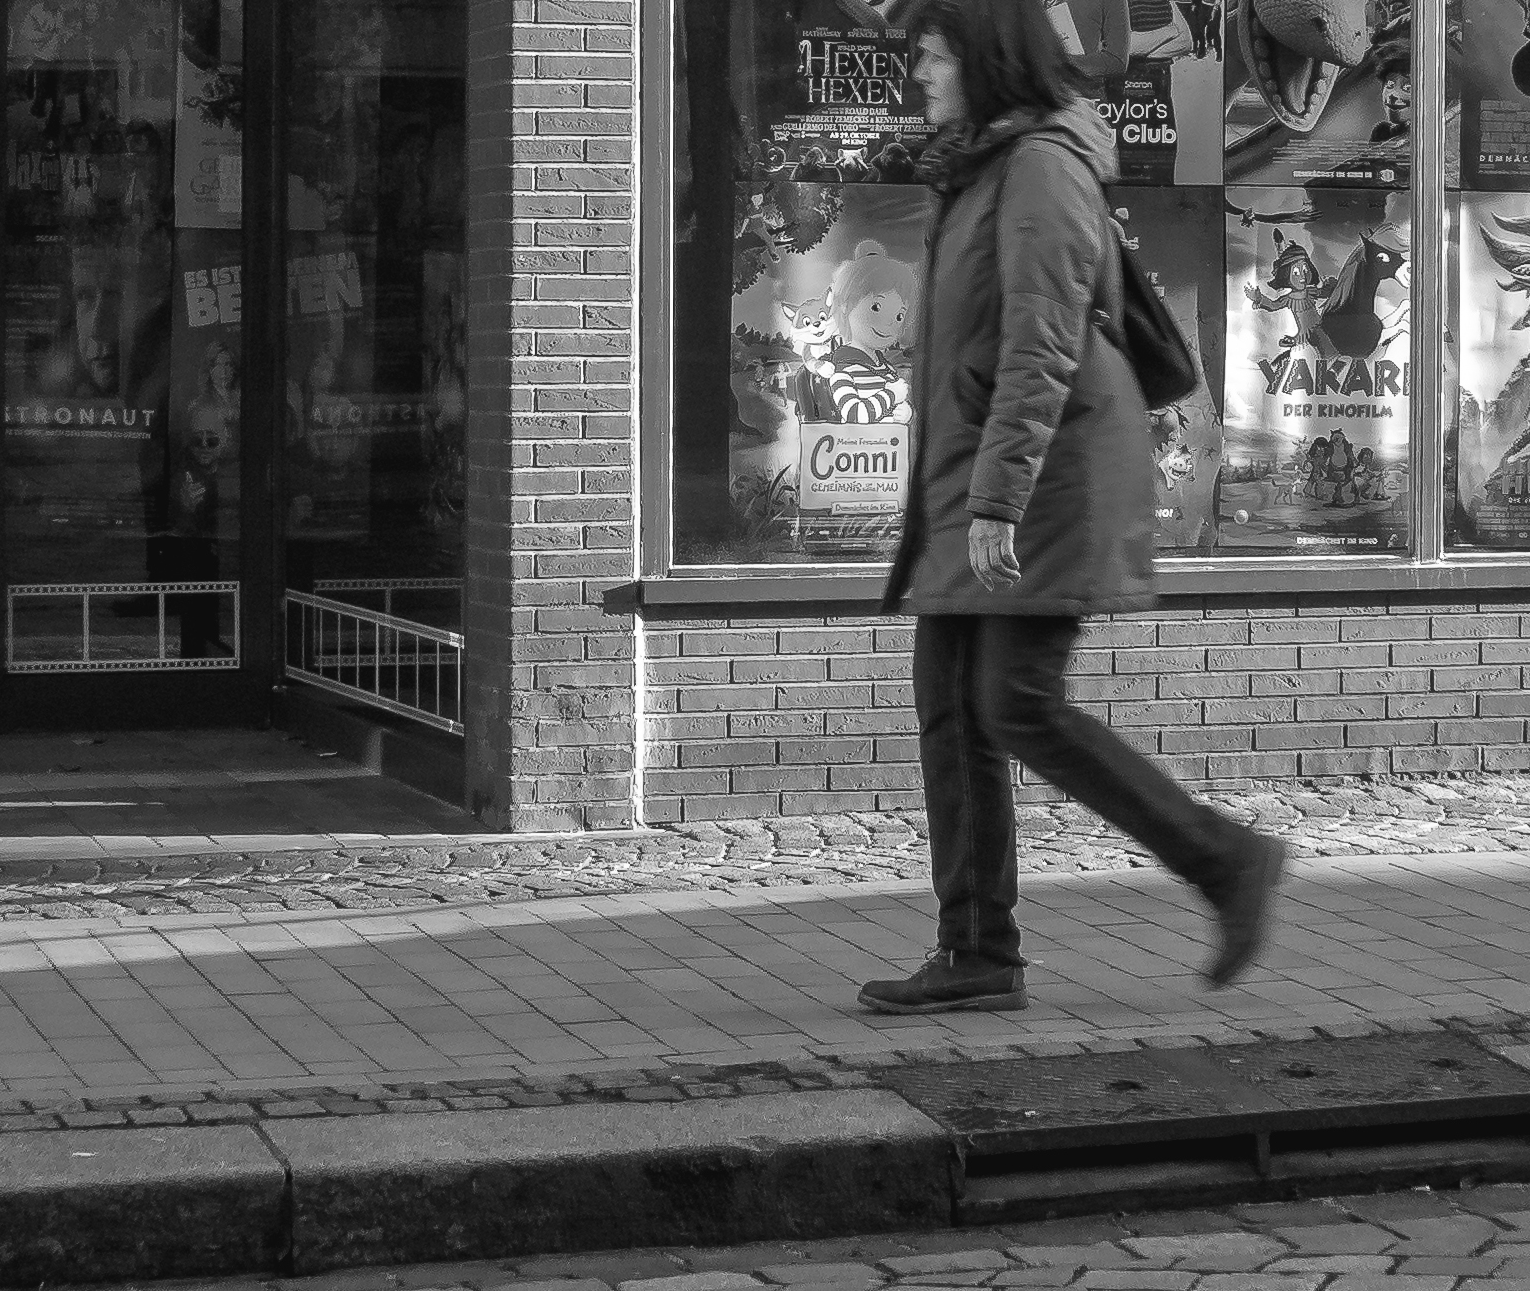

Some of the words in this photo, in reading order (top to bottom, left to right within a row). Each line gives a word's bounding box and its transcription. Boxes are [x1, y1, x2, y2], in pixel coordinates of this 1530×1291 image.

[797, 39, 909, 79] HEXEN
[806, 77, 904, 105] HEXEN
[1122, 123, 1177, 144] Club
[1283, 403, 1313, 418] DER
[1317, 403, 1394, 419] KINOFILM
[810, 434, 900, 481] Conni
